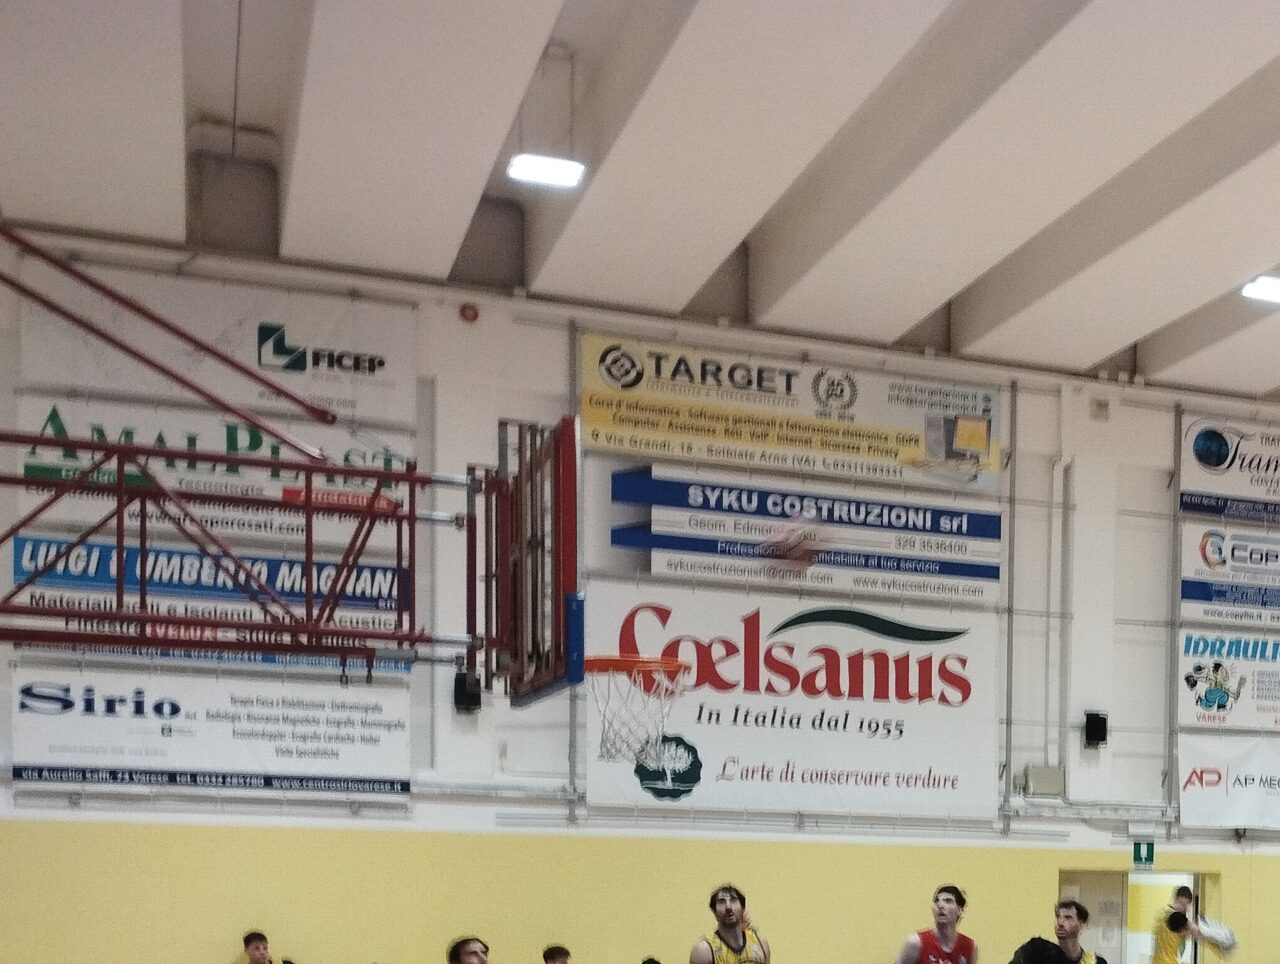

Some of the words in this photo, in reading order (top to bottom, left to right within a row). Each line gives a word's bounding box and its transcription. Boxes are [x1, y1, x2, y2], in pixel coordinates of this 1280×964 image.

[312, 348, 385, 375] FICEP
[647, 351, 800, 396] TARGET
[605, 433, 624, 447] Via
[688, 484, 758, 513] SYKU
[766, 493, 933, 531] COSTRUZIONI
[939, 512, 968, 535] srl
[19, 682, 181, 720] Sirio
[1196, 711, 1227, 724] VARESE
[695, 702, 721, 726] In
[732, 704, 801, 730] Italia
[812, 710, 849, 733] dal
[858, 717, 905, 740] 1955
[715, 755, 775, 783] L'arte
[780, 761, 796, 784] di
[800, 766, 891, 788] conservare
[895, 767, 960, 791] verdure
[1233, 773, 1255, 789] AP
